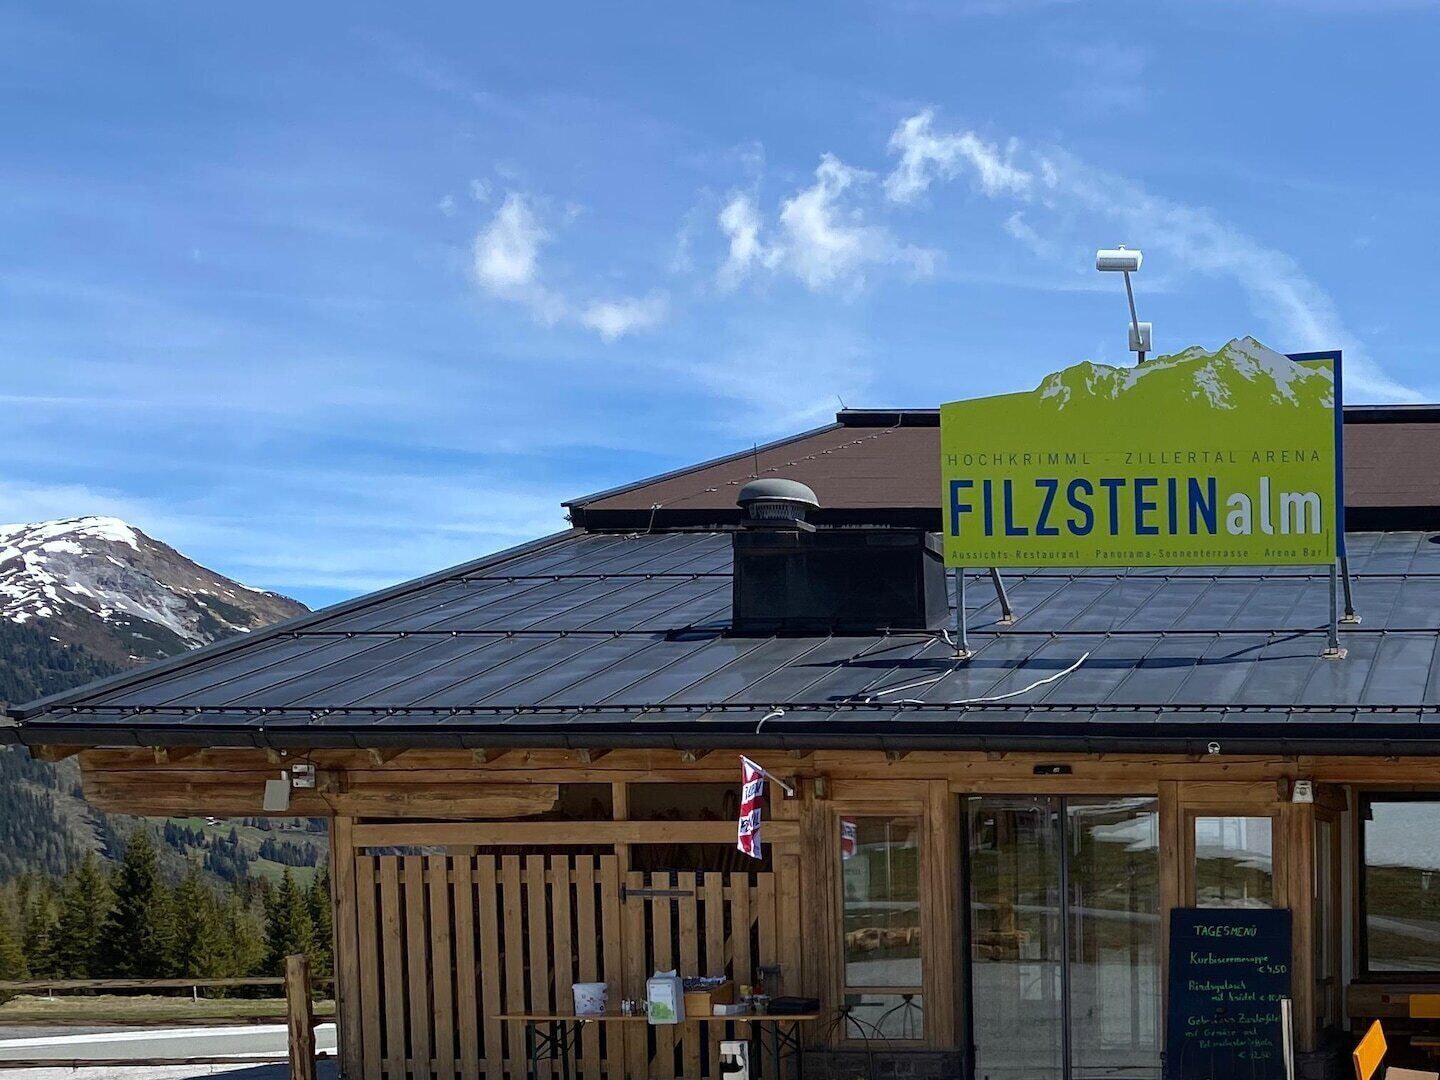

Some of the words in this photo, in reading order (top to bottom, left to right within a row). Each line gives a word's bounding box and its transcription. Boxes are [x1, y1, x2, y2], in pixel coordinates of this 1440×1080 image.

[948, 452, 1091, 466] HOCHKRIMML
[1125, 452, 1237, 465] ZILLERTAL
[1251, 450, 1321, 463] ARENA
[1264, 547, 1297, 558] Arena
[1303, 547, 1322, 557] Bar
